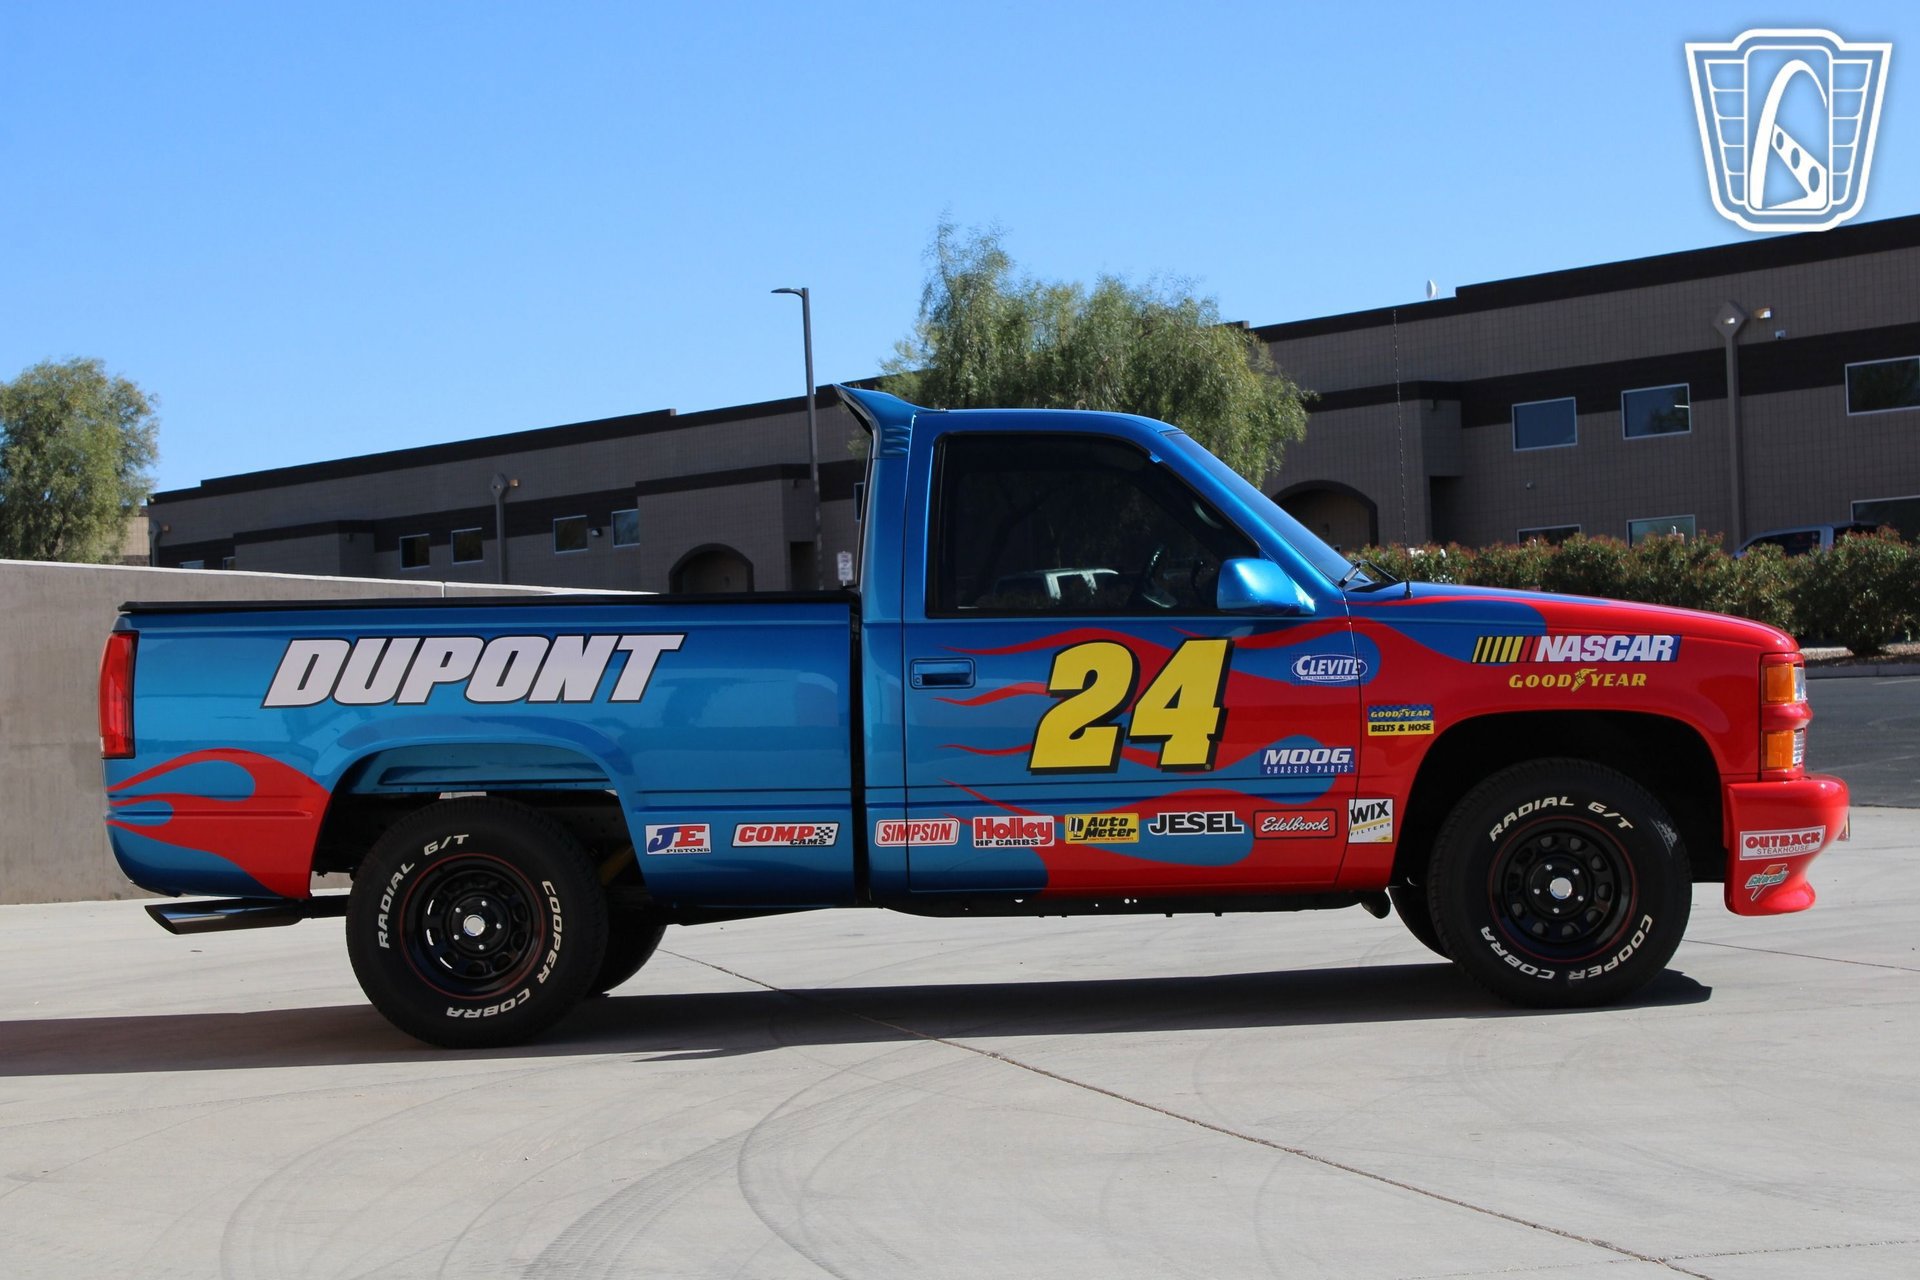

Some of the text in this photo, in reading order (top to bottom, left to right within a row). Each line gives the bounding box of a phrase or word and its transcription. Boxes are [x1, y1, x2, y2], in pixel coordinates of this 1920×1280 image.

[1535, 635, 1675, 662] NASCAR
[261, 633, 687, 708] DUPONT
[1296, 655, 1362, 676] CLEVITE
[1027, 638, 1234, 775] 24
[1371, 724, 1396, 732] BELTS
[1408, 723, 1431, 731] HOSE
[1263, 748, 1352, 765] MOOG
[1266, 765, 1349, 774] CHASSIS PARTS
[1087, 816, 1129, 827] Auto
[1350, 800, 1390, 825] WIX
[1488, 796, 1634, 842] RADIAL G/T
[738, 825, 815, 843] COMP
[881, 823, 953, 842] SIMPSON
[975, 817, 1053, 845] Holley
[1083, 827, 1137, 840] Meter
[1148, 812, 1244, 835] JESEL
[1261, 815, 1329, 832] Edelbrock
[648, 825, 706, 853] JE
[790, 838, 827, 846] CAMS
[1745, 832, 1821, 849] OUTBACK
[1756, 844, 1809, 855] STEAKHOUSE
[378, 833, 470, 949] RADIAL G/T
[446, 880, 563, 1019] COOPER COBRA
[1480, 914, 1653, 981] COOPER COBRA
